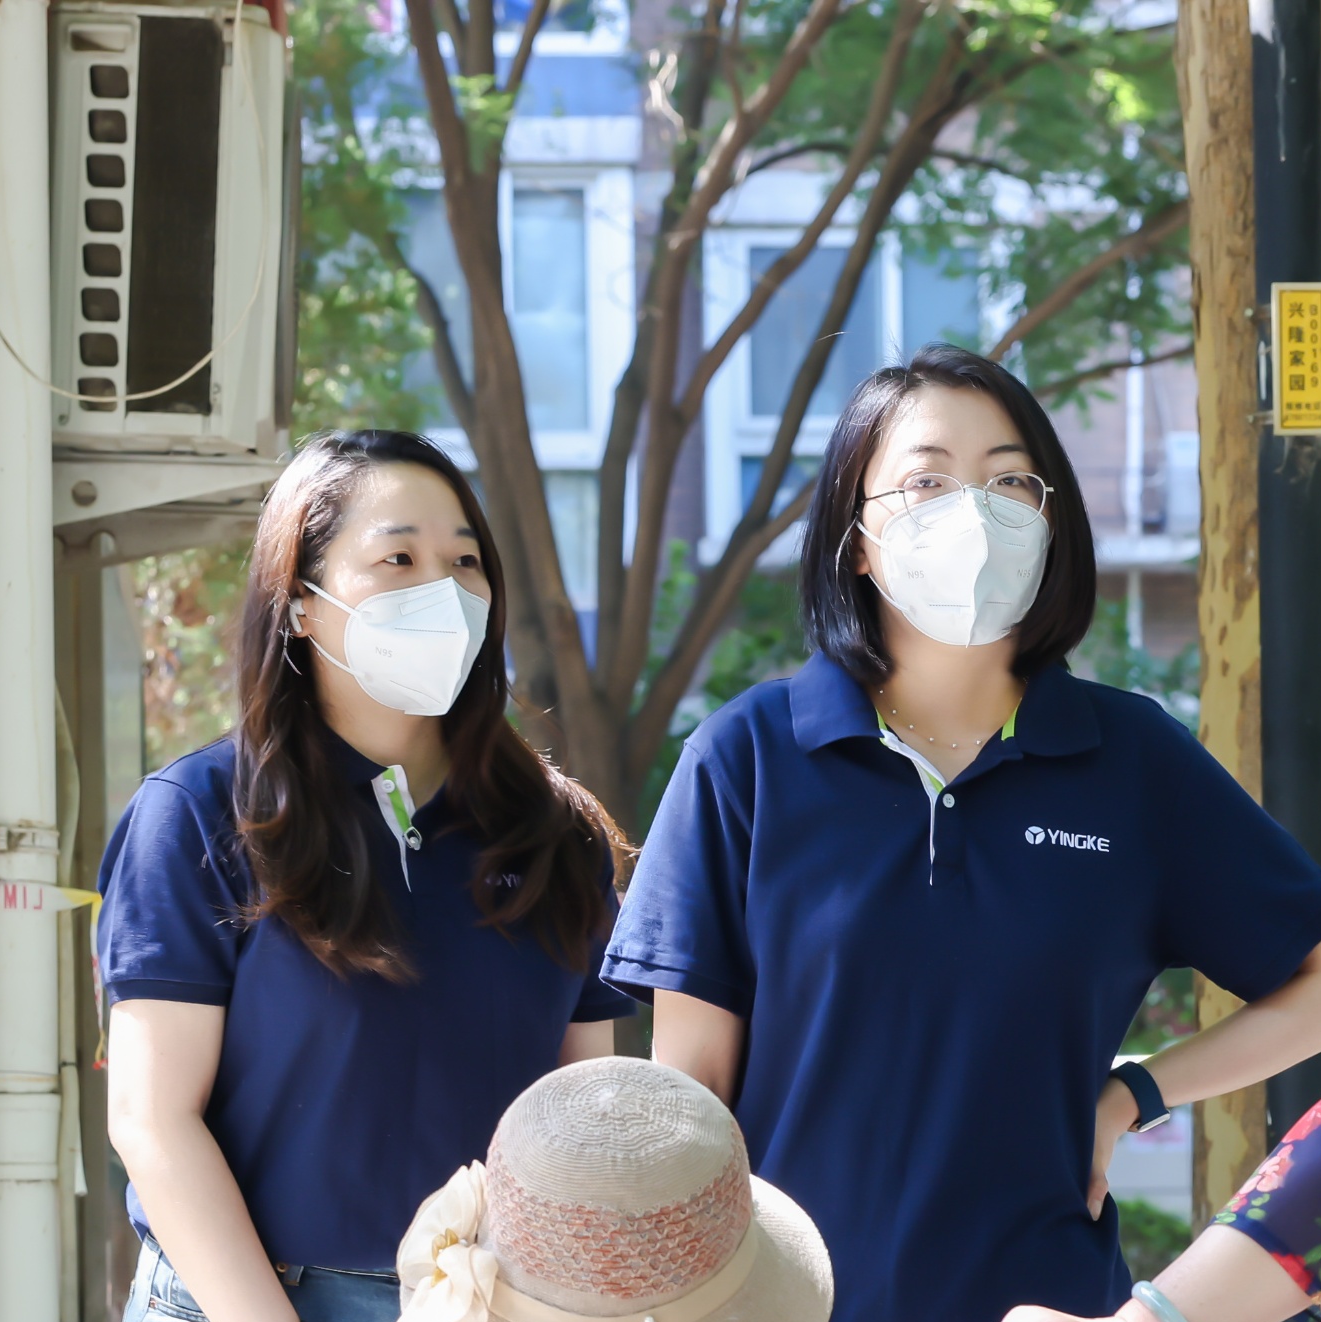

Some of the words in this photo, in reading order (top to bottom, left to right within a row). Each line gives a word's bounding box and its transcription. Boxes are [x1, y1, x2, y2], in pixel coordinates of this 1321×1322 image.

[907, 570, 925, 580] N95
[375, 646, 393, 658] N95
[1047, 828, 1110, 853] YINGKE
